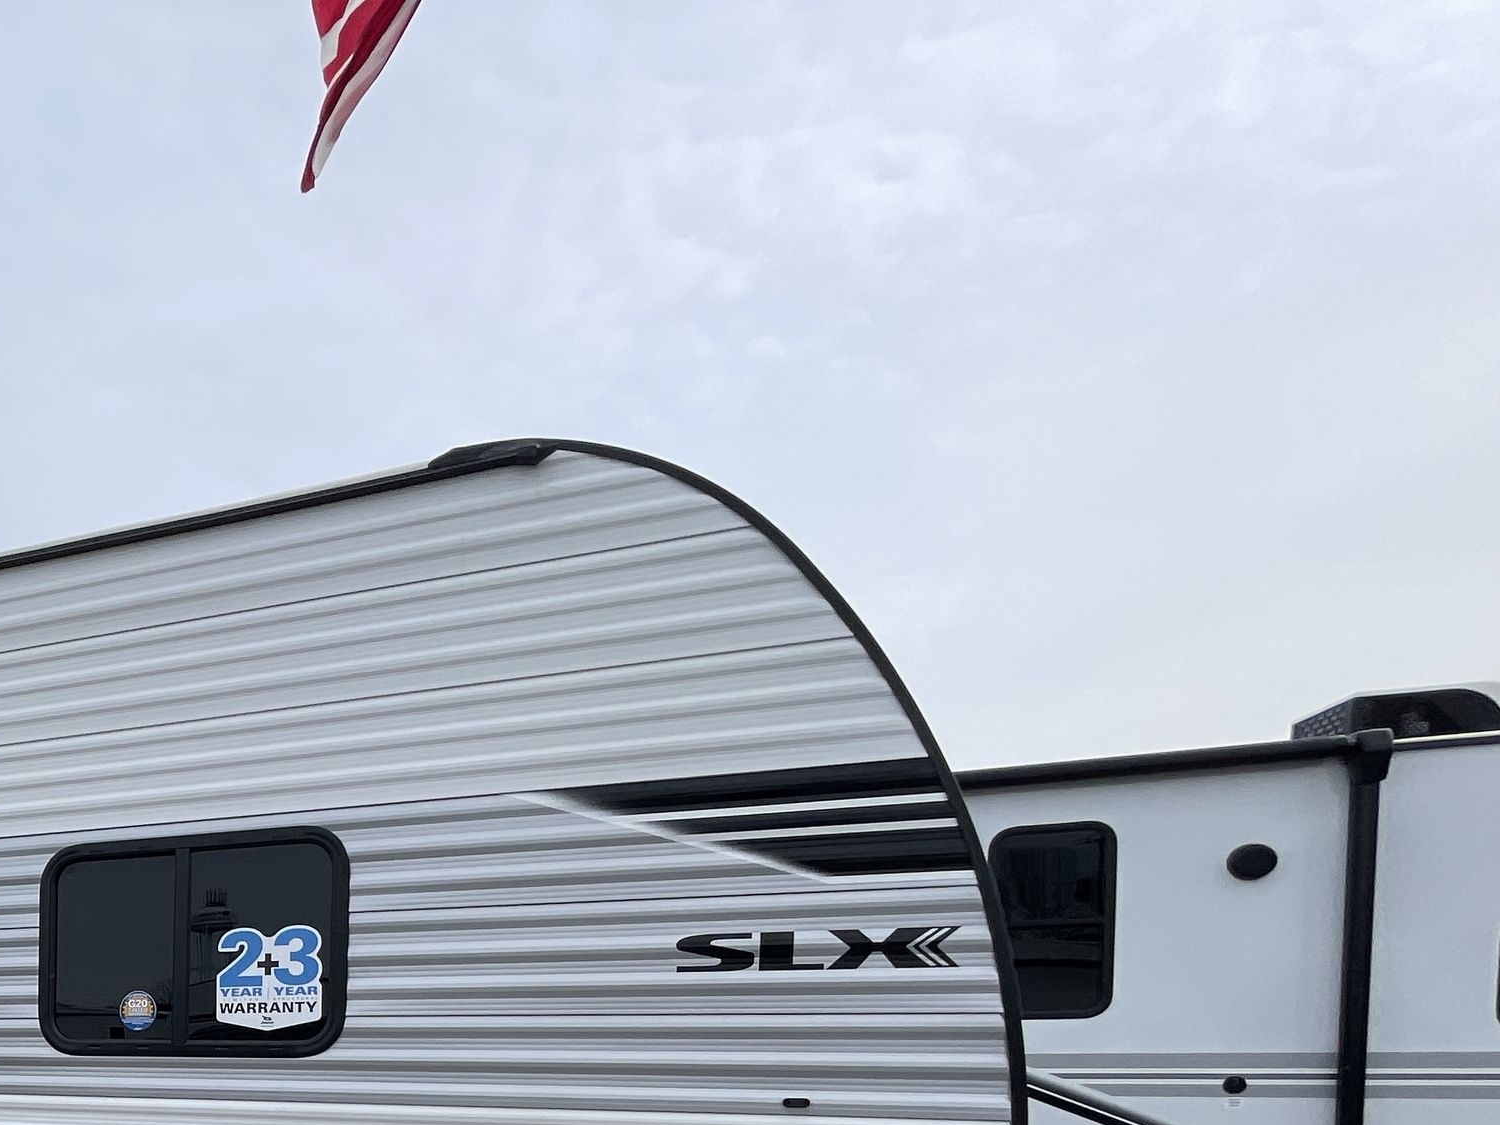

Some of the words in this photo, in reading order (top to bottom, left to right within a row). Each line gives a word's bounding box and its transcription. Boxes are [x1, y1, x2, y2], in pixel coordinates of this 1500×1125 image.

[675, 926, 961, 972] SLX
[219, 988, 263, 997] YEAR
[273, 986, 318, 996] YEAR
[128, 999, 148, 1008] G20
[219, 1001, 318, 1014] WARRANTY
